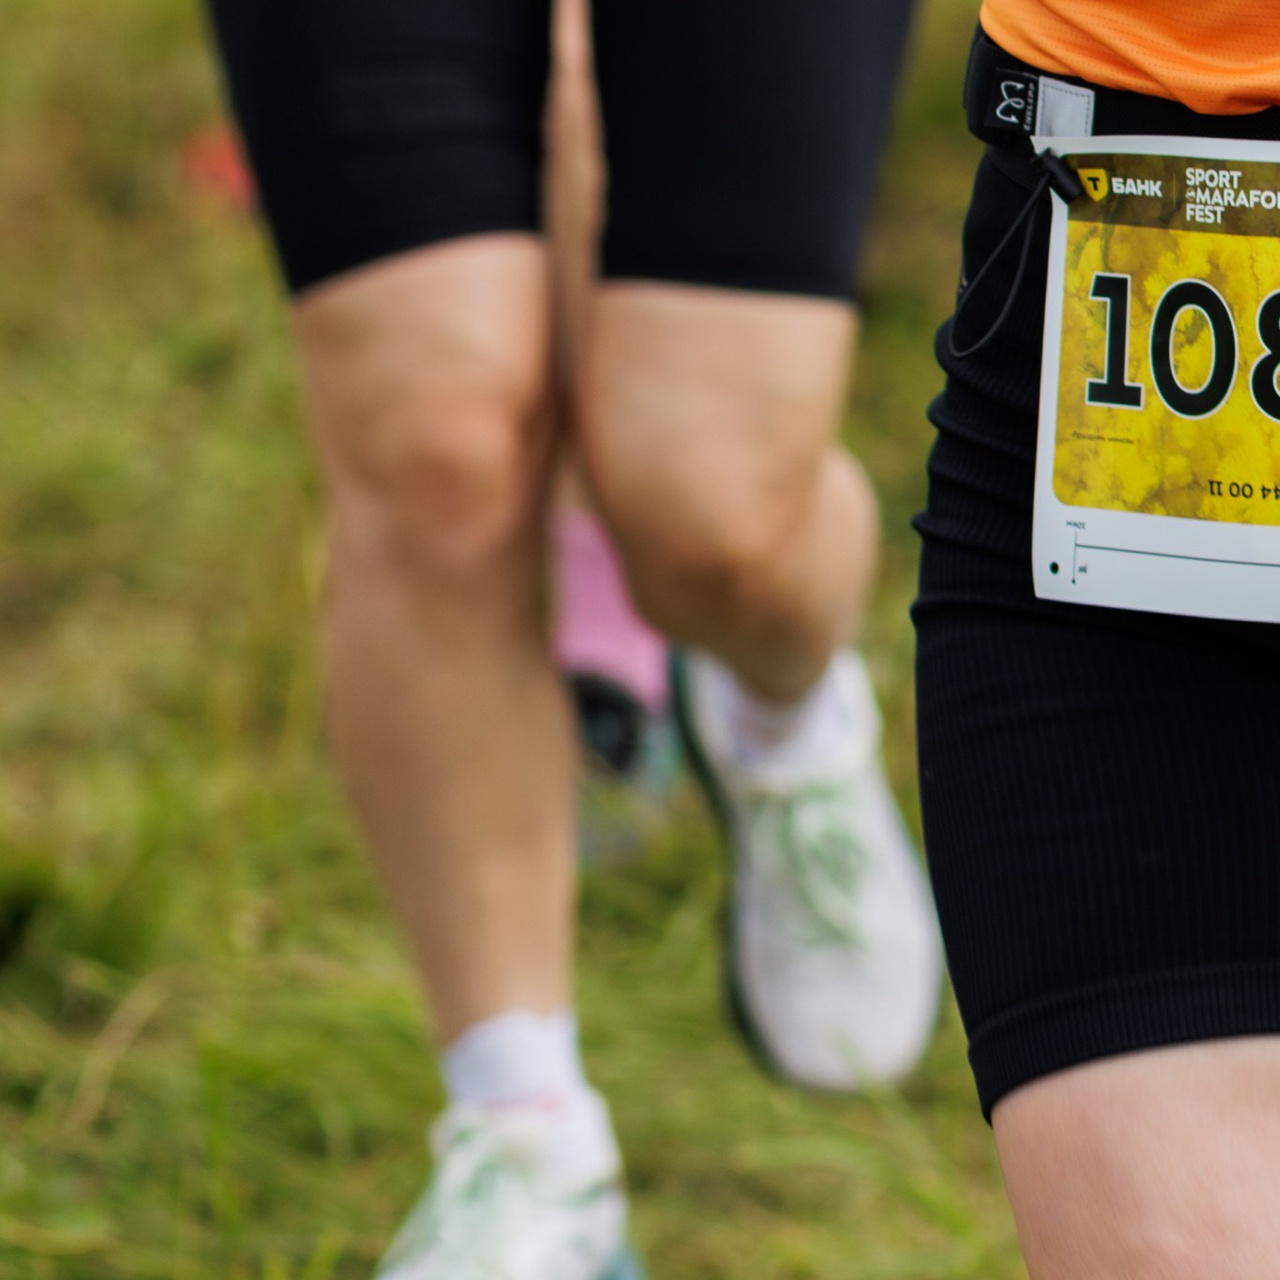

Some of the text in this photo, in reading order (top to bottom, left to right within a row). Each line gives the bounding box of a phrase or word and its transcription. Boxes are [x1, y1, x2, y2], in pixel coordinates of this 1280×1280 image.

[1111, 177, 1163, 198] БАНК
[1185, 167, 1242, 188] SPORT
[1186, 204, 1224, 224] FEST
[1208, 479, 1222, 496] 11
[1229, 482, 1253, 498] 00
